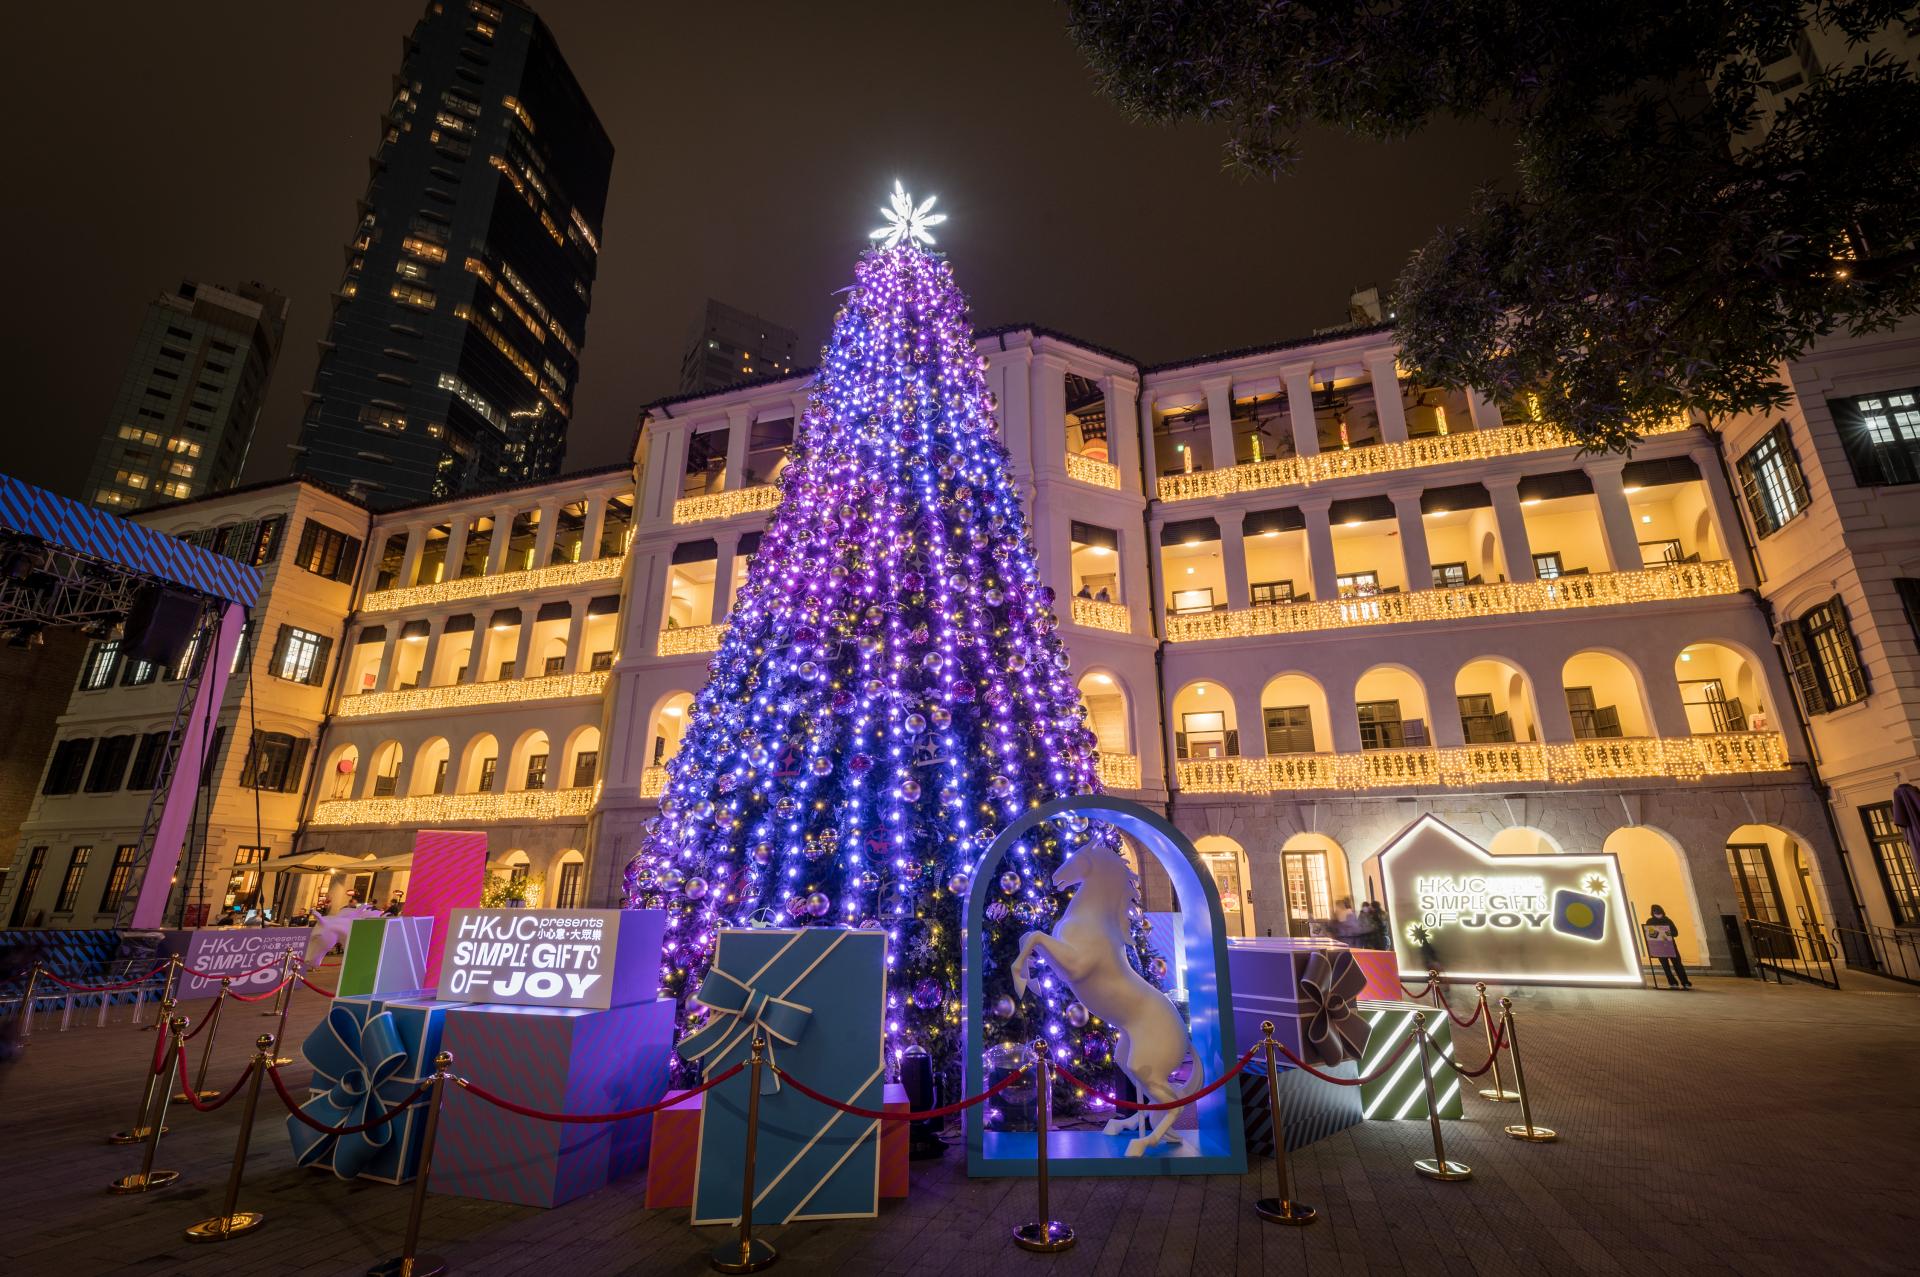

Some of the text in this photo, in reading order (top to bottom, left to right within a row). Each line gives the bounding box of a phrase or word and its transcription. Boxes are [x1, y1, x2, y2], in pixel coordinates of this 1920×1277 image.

[1419, 879, 1486, 893] HKJC
[1422, 895, 1547, 910] SIMPLE GIFTS
[458, 916, 604, 940] HKJC presents
[1425, 913, 1550, 928] OF JOY
[537, 928, 602, 941] 小心意·大眾樂
[198, 937, 262, 954] HKJC
[194, 951, 304, 971] SIMPLE GIFS
[453, 941, 601, 970] SIMPLE GIFTS
[451, 969, 602, 998] OF JOY
